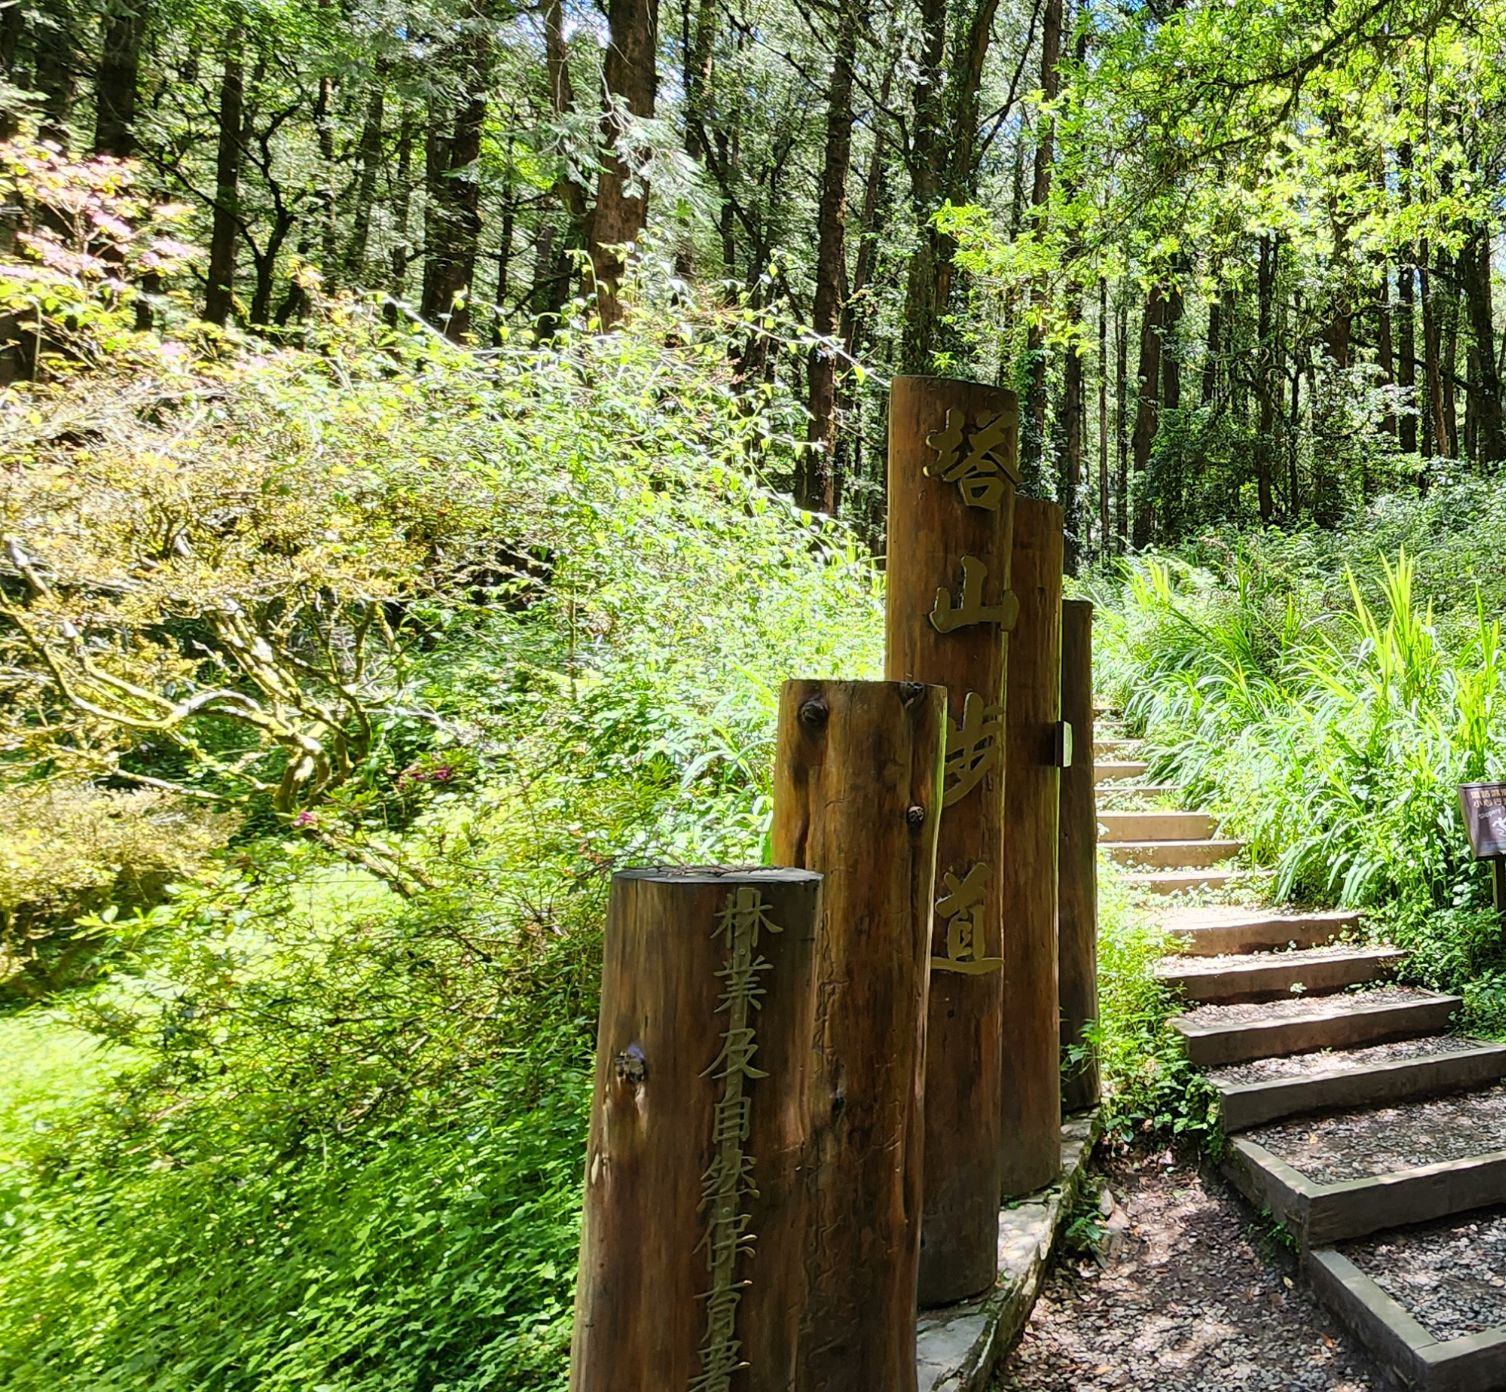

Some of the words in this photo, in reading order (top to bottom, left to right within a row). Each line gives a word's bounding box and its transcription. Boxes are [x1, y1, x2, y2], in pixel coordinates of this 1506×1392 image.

[922, 407, 1023, 976] 塔山步道
[688, 887, 784, 1392] 林業及自然保育署
